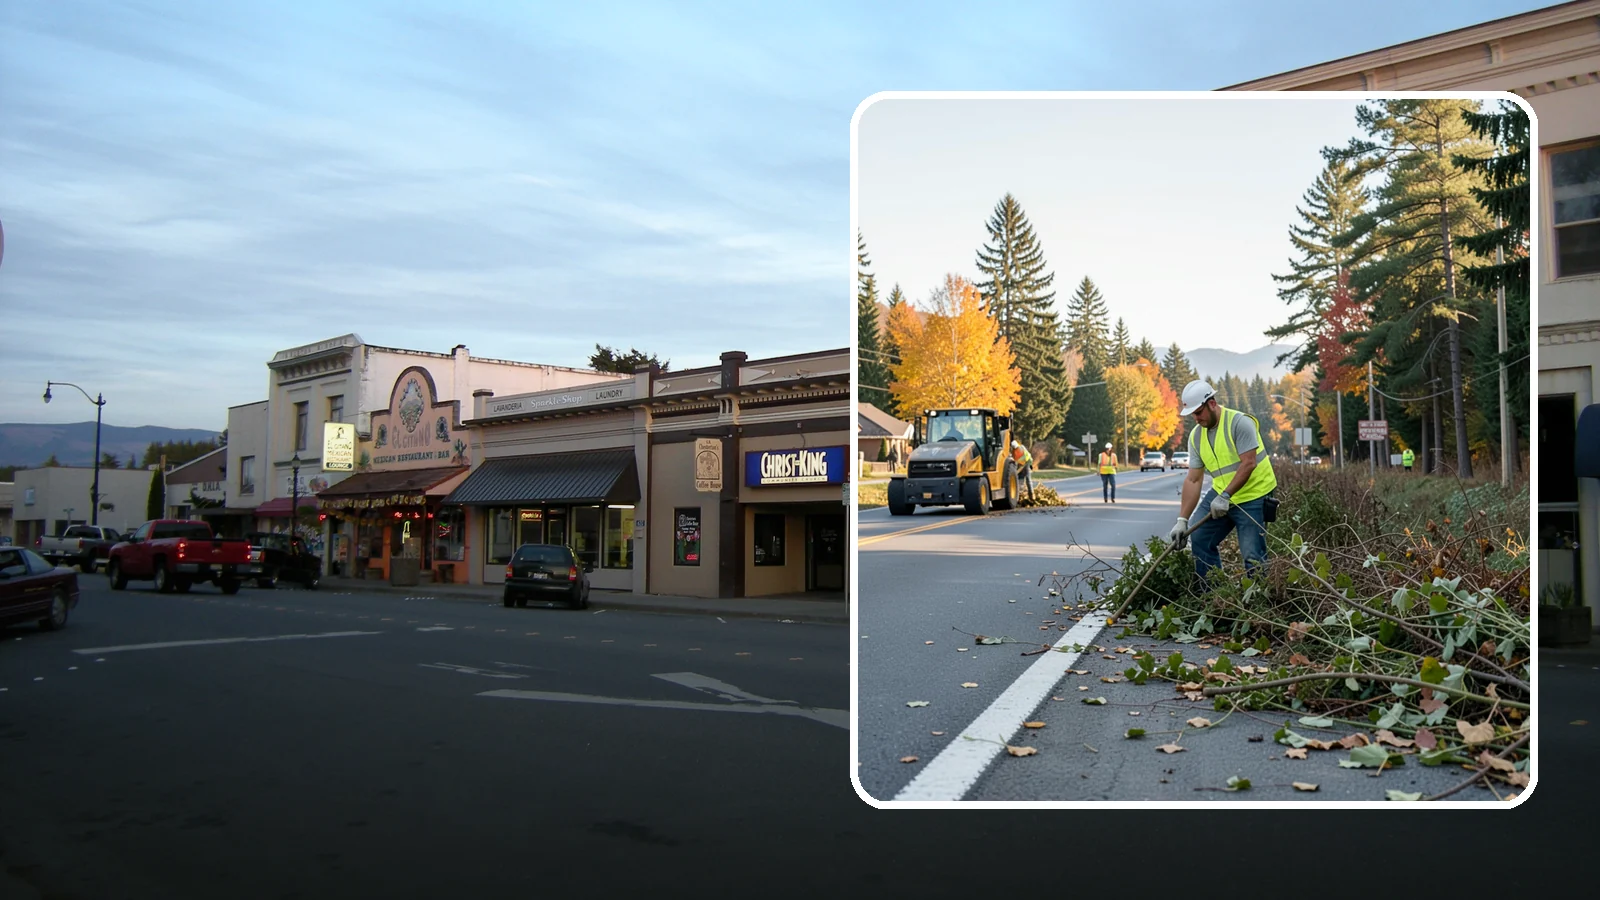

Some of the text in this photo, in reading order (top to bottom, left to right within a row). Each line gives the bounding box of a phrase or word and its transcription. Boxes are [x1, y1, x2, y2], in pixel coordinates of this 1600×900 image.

[530, 394, 582, 408] Sparkle Shop
[595, 389, 624, 400] LAUNDRY
[493, 402, 522, 412] LAVANDERIA
[373, 454, 396, 464] MEXICAN
[397, 451, 433, 462] RESTAURANT
[438, 450, 450, 459] BAR
[799, 450, 827, 476] KING
